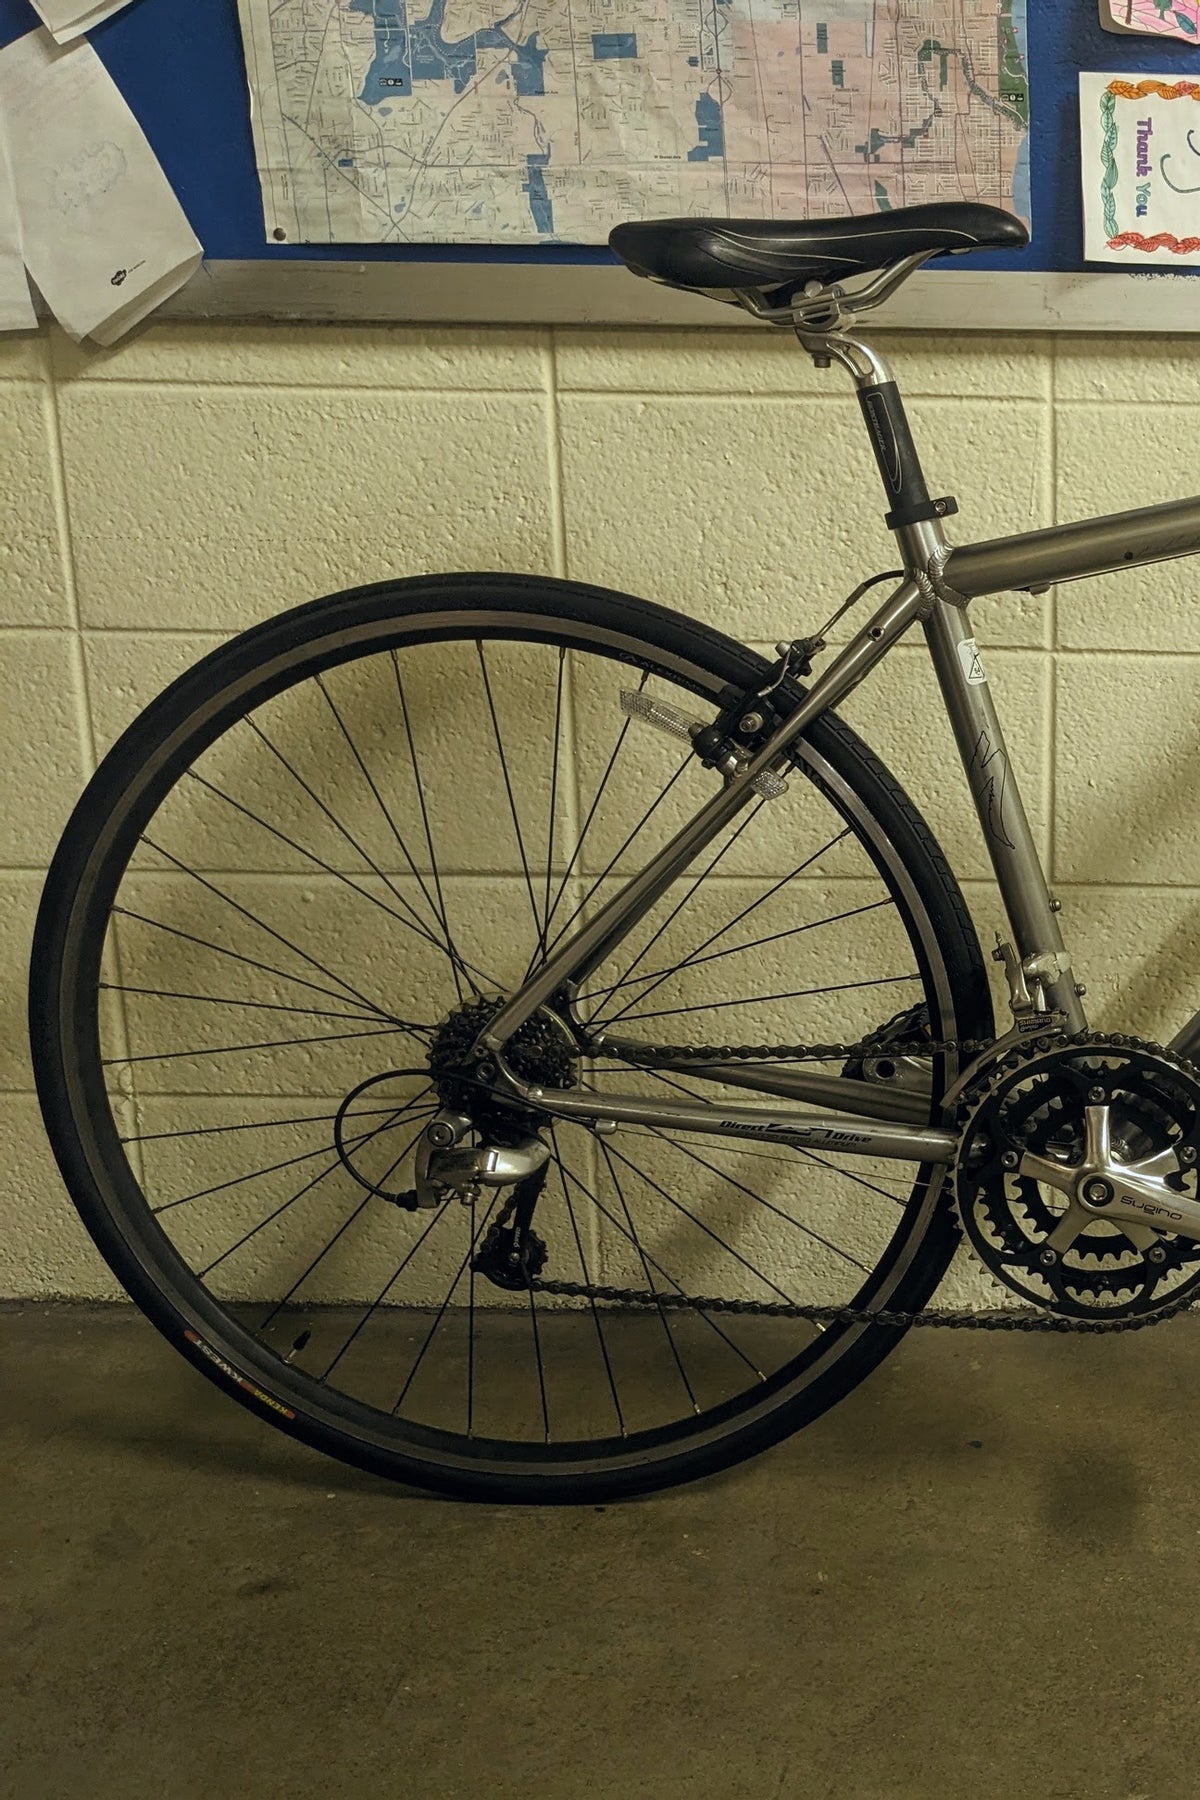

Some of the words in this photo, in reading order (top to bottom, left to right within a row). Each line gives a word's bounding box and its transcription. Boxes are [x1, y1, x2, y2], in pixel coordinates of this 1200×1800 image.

[1136, 117, 1153, 178] Thank
[1135, 182, 1152, 217] You
[719, 1120, 765, 1132] Direct
[832, 1132, 873, 1144] Drive
[193, 1339, 244, 1384] KWEST
[254, 1388, 289, 1415] KENDA
